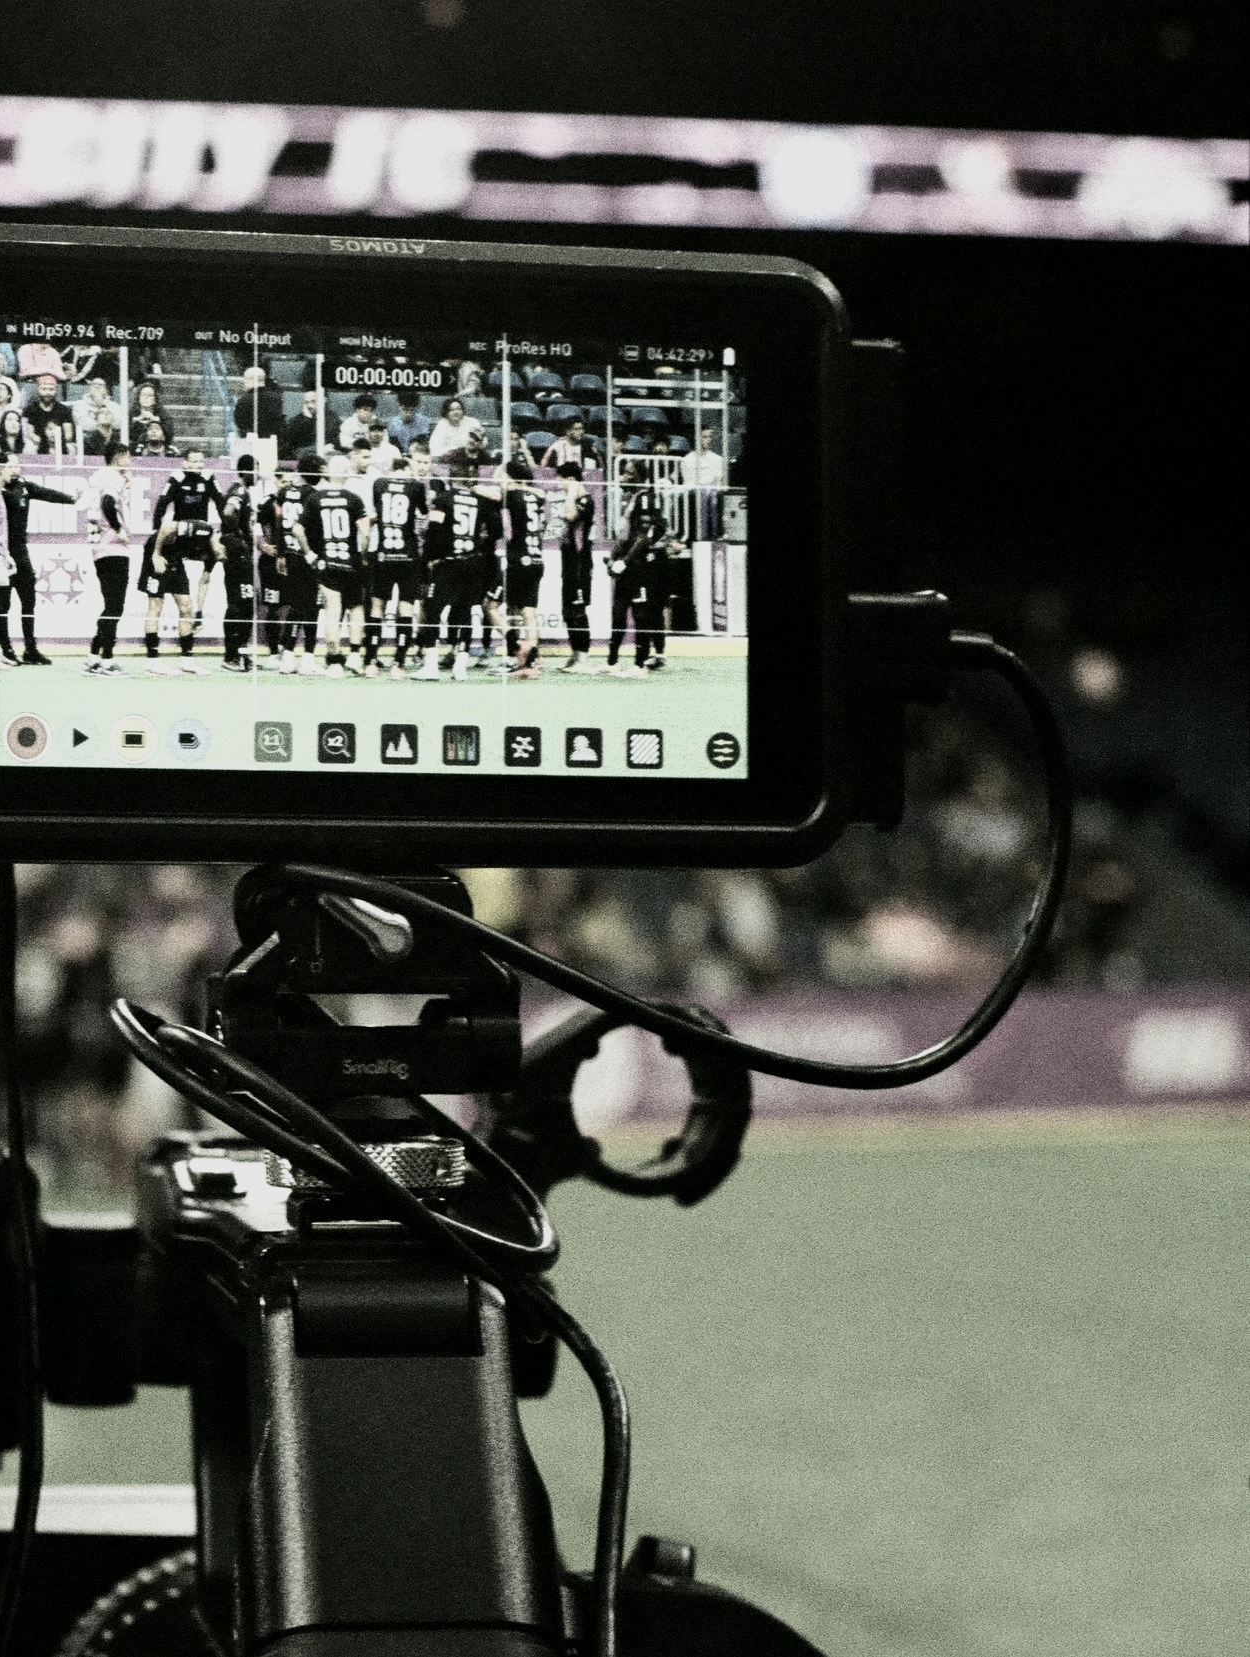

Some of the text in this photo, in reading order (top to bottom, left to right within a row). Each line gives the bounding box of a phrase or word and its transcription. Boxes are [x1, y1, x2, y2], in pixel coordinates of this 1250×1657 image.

[329, 238, 425, 254] ATOMOS
[23, 322, 95, 341] HDp59.94
[105, 325, 165, 341] Rec.709
[219, 329, 241, 343] No
[244, 330, 292, 348] Output
[361, 334, 407, 350] Native
[495, 340, 547, 355] ProRes
[549, 342, 573, 357] HQ
[334, 366, 442, 387] 00:00:00:00
[381, 492, 410, 525] 18
[320, 508, 351, 540] 10
[452, 503, 478, 537] 51
[342, 1058, 409, 1080] SmallRig
